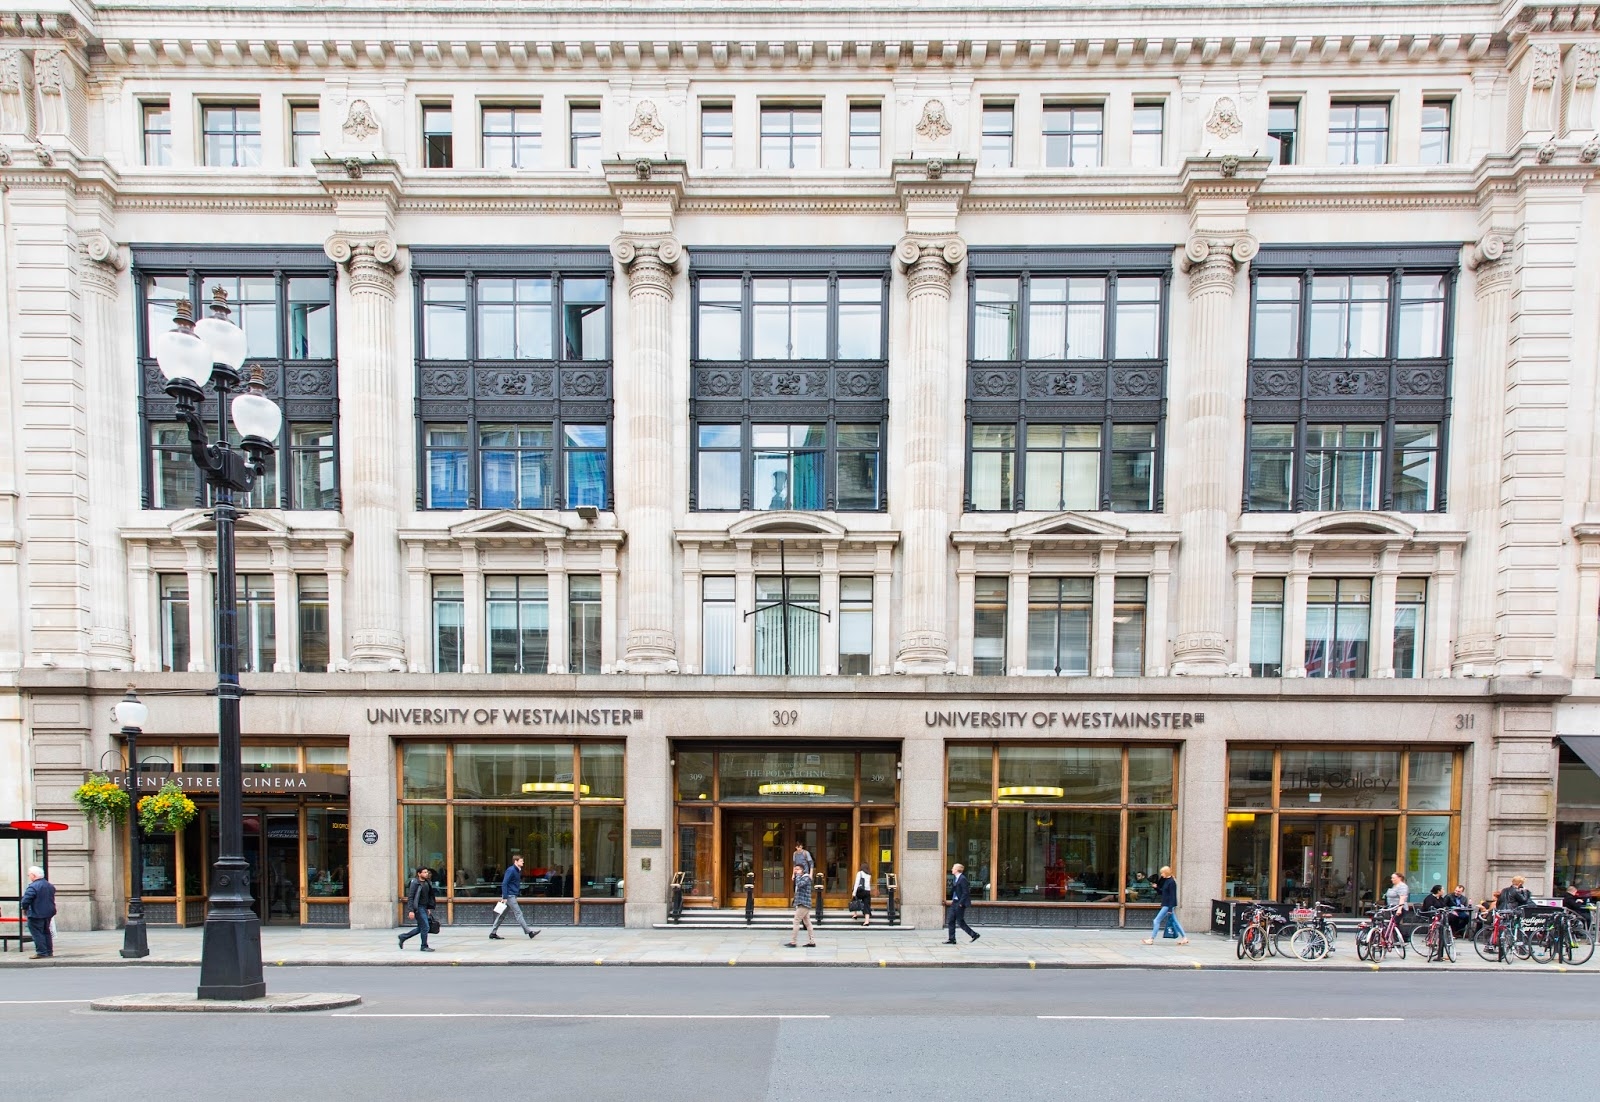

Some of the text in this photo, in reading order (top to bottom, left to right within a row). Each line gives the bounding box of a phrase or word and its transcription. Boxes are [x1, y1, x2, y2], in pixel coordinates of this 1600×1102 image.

[366, 708, 632, 725] UNIVERSITY OF WESTMINSTER
[772, 710, 798, 726] 309
[925, 711, 1193, 729] UNIVERSITY OF WESTMINSTER
[1455, 713, 1475, 730] 311
[689, 773, 703, 781] 309
[745, 769, 830, 778] THE POLYTECHNIC
[871, 774, 885, 782] 309
[105, 776, 307, 788] EGENT STREE CINEMA
[1288, 771, 1391, 793] The Gallery
[1410, 827, 1446, 840] Boutique
